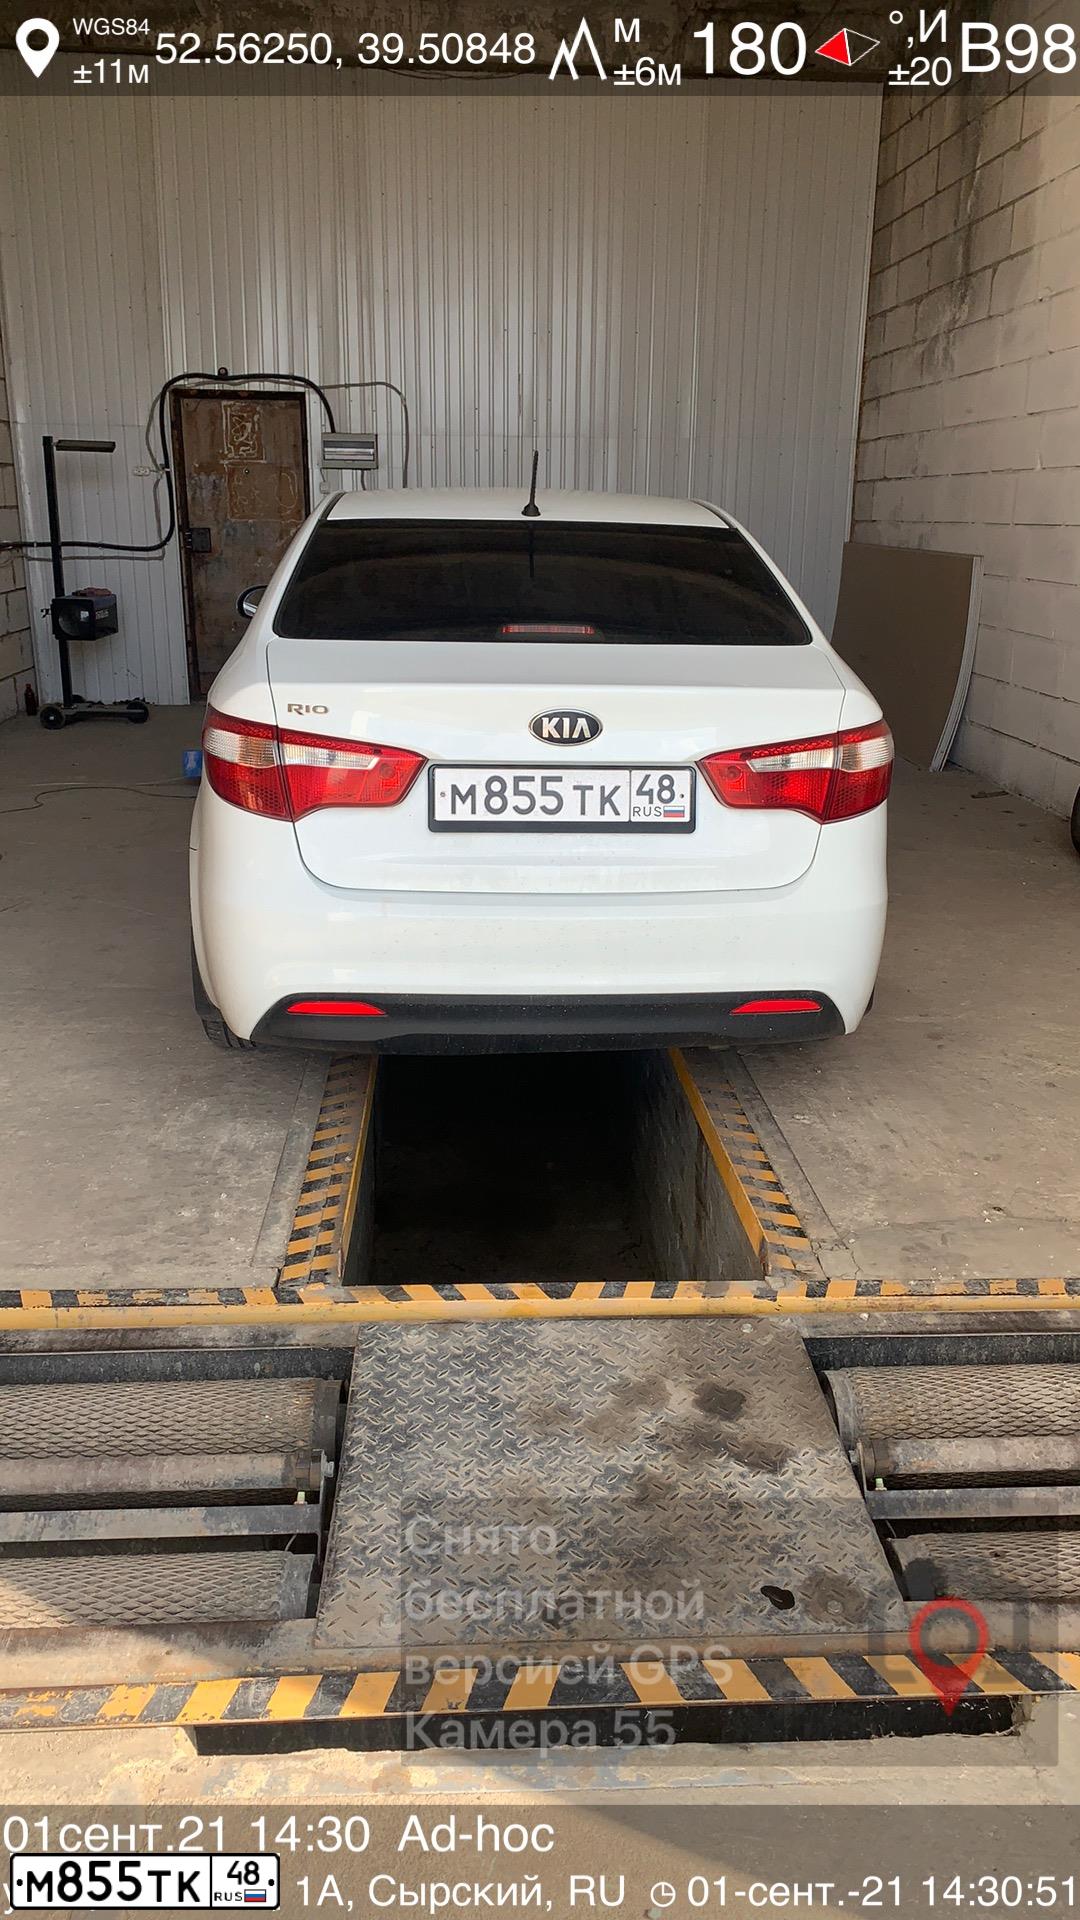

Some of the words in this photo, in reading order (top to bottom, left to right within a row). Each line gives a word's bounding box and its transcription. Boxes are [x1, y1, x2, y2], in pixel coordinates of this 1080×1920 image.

[287, 703, 329, 715] RIO
[541, 717, 591, 739] KIA
[449, 774, 621, 816] М855ТК
[635, 773, 675, 805] 48
[632, 805, 662, 818] RUS
